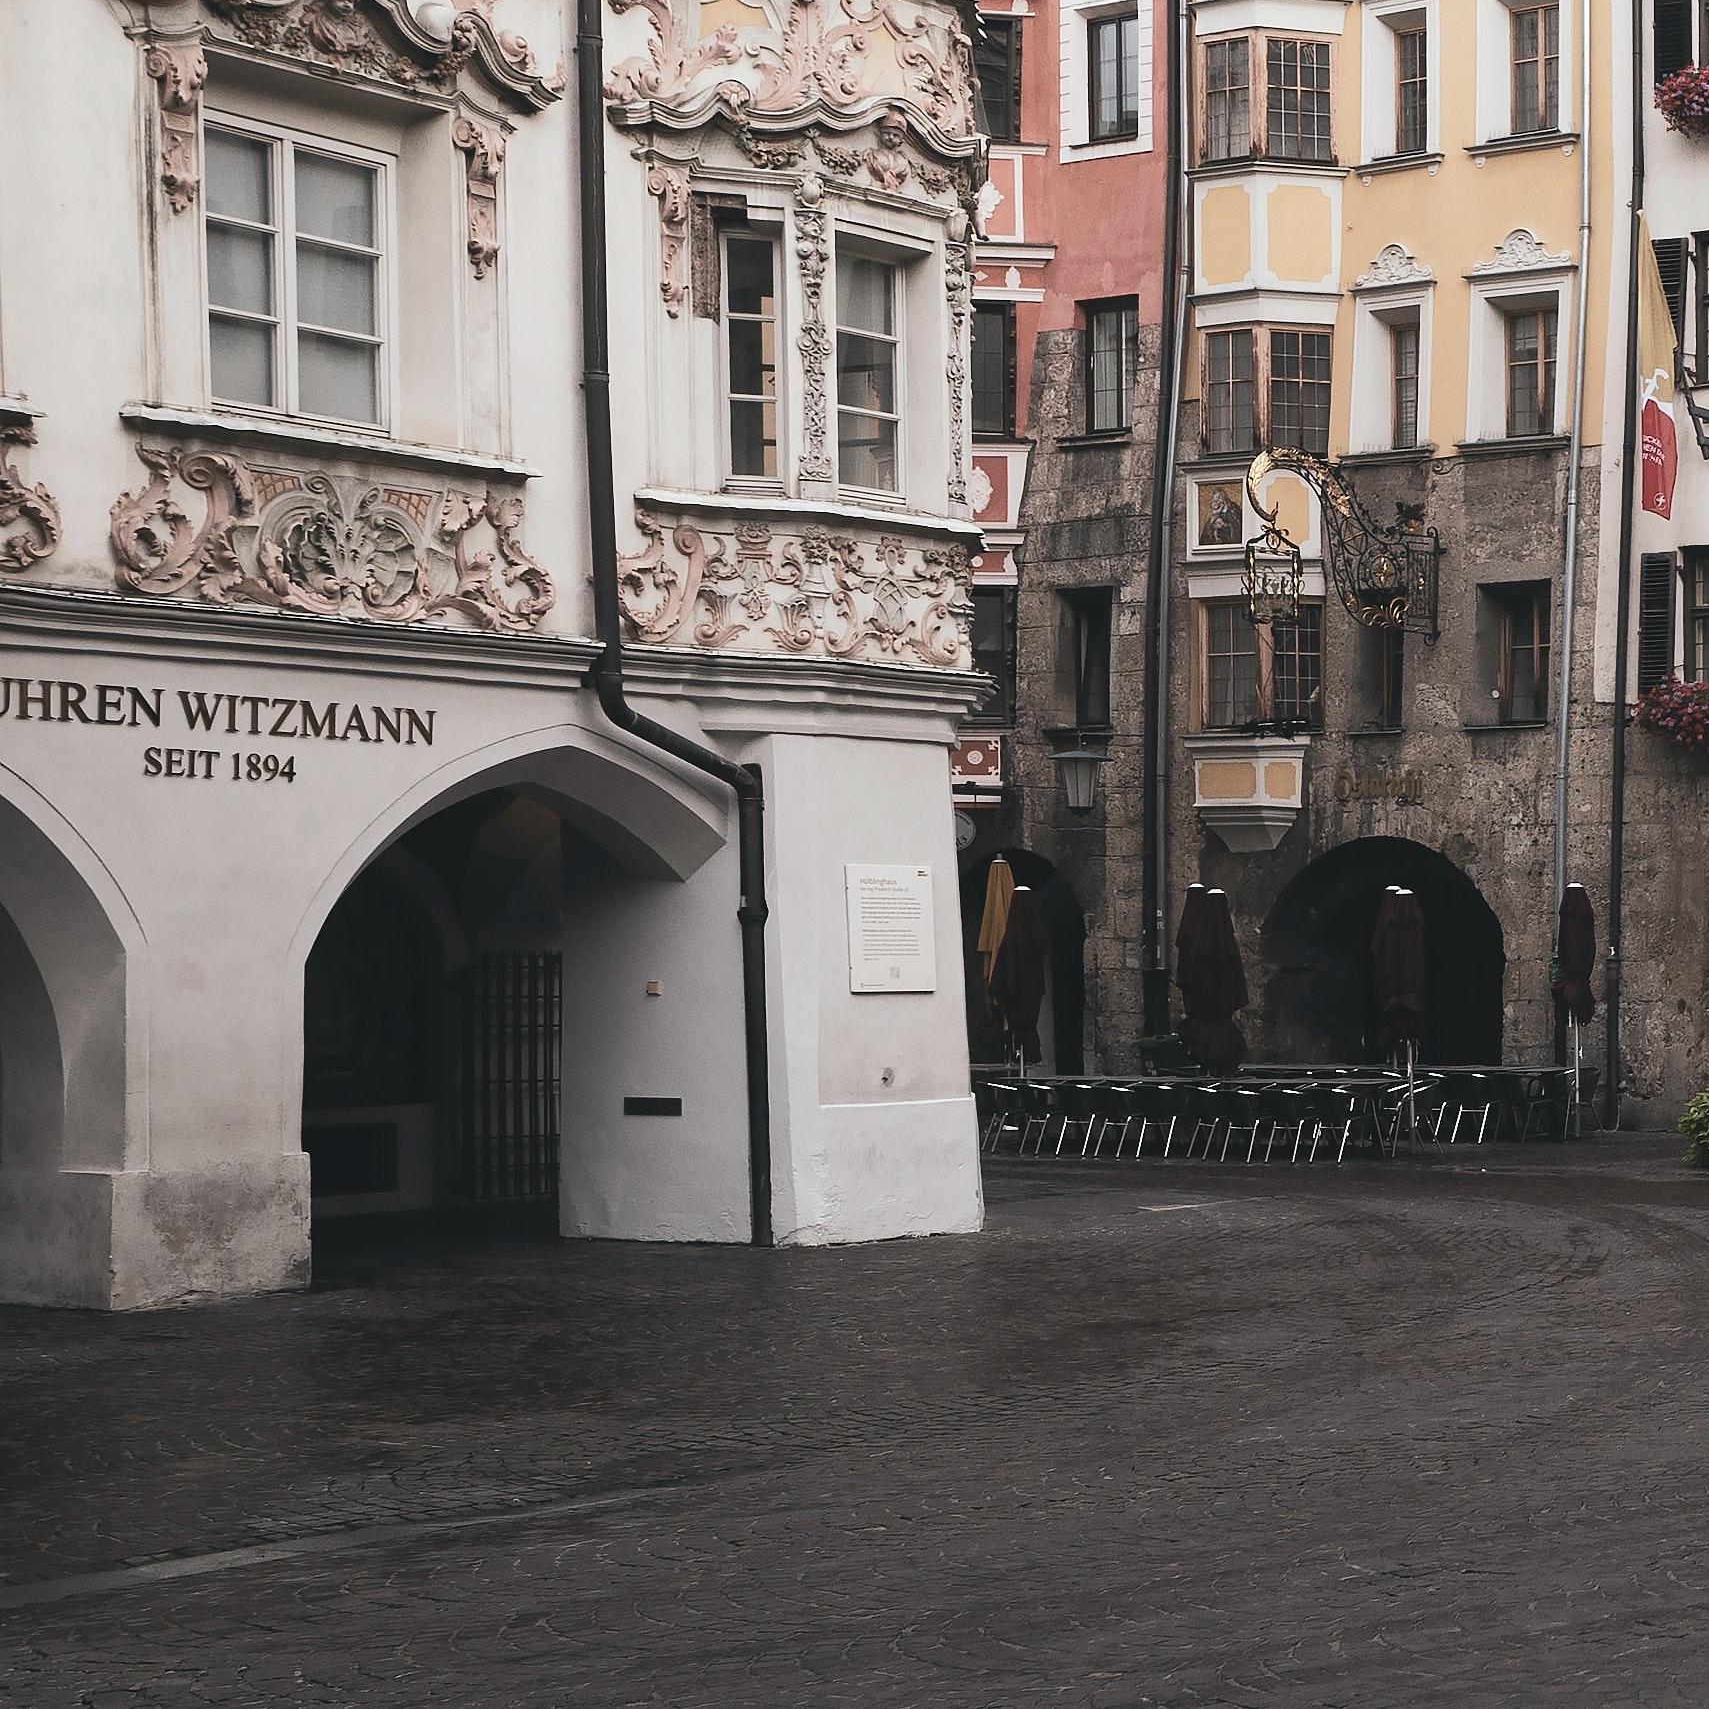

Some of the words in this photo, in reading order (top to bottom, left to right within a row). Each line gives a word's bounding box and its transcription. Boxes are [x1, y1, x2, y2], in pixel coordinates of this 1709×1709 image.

[177, 690, 438, 747] WITZMANN
[143, 746, 220, 780] SEIT
[231, 752, 297, 783] 1894
